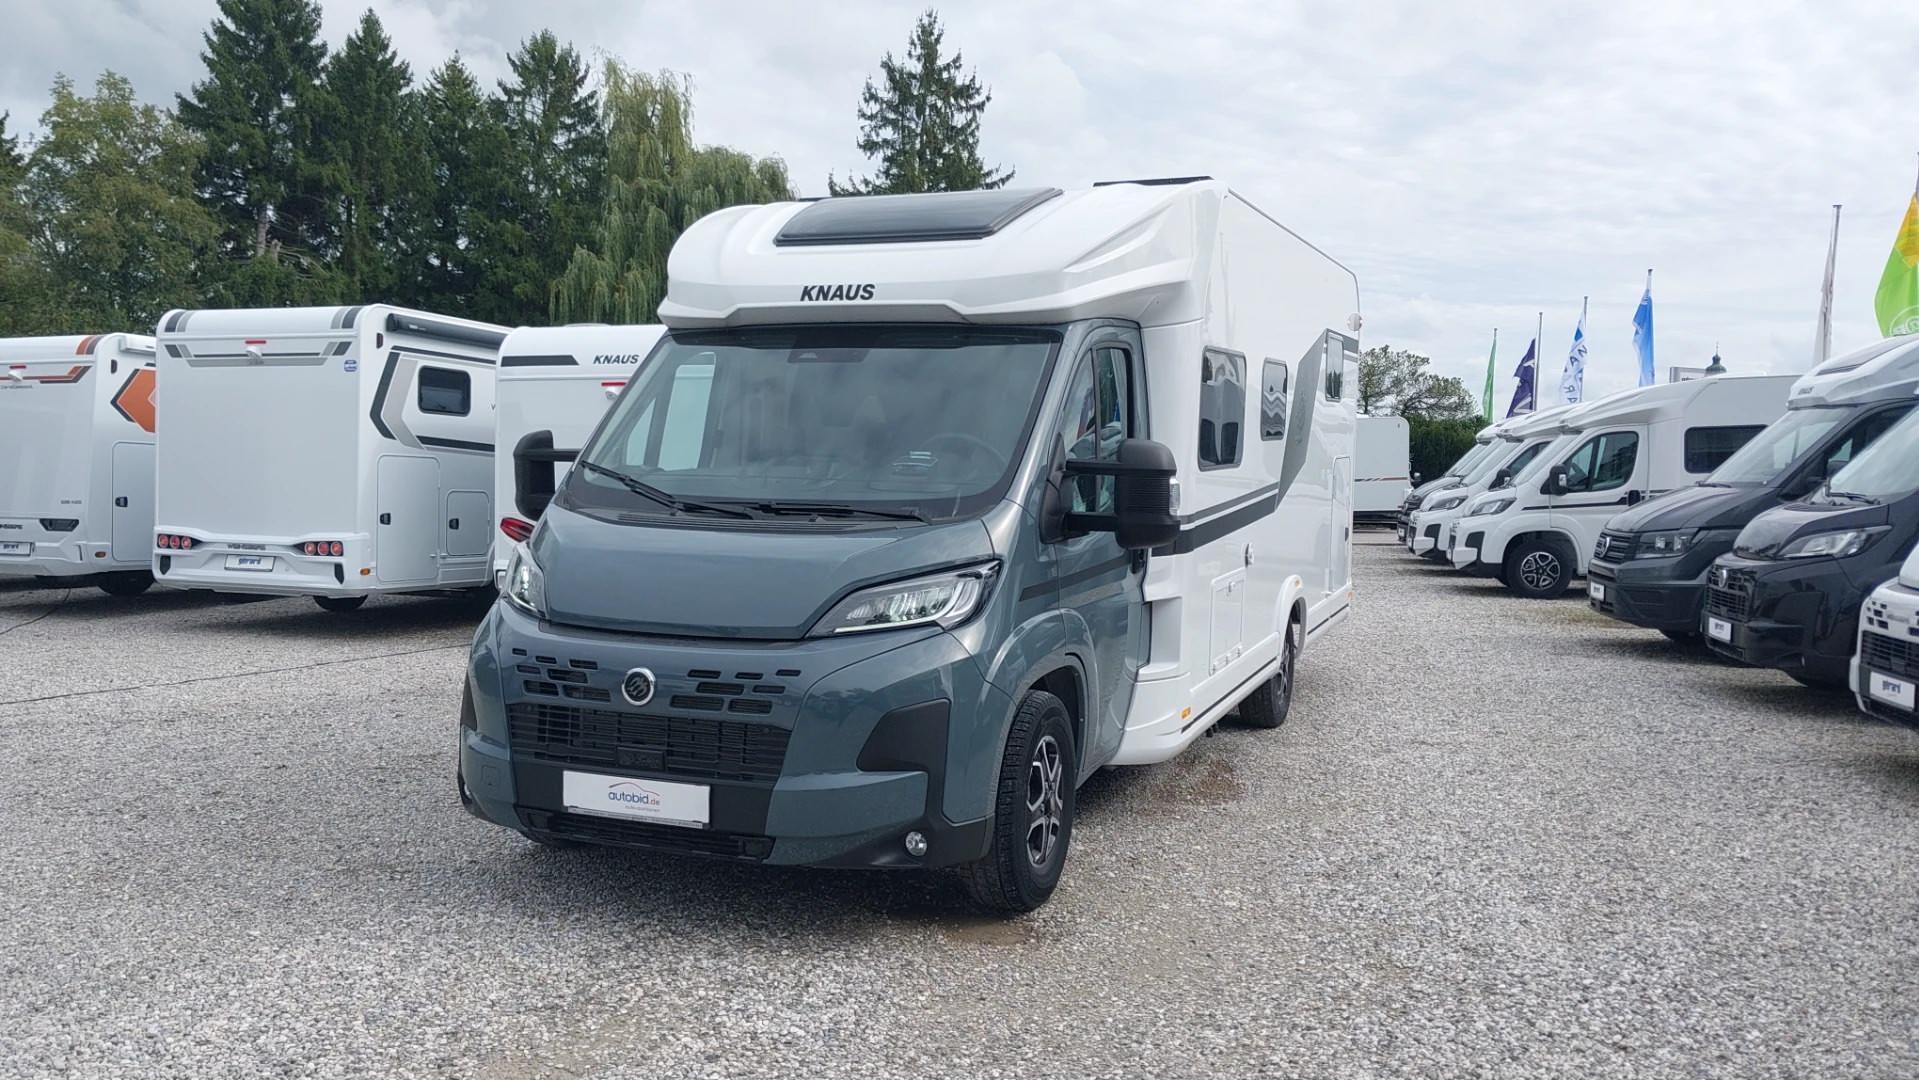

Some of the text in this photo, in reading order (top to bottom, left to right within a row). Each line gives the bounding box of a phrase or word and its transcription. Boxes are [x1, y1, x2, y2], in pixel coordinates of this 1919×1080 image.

[800, 283, 876, 302] KNAUS
[593, 354, 640, 365] KNAUS
[608, 790, 660, 806] autobid.de
